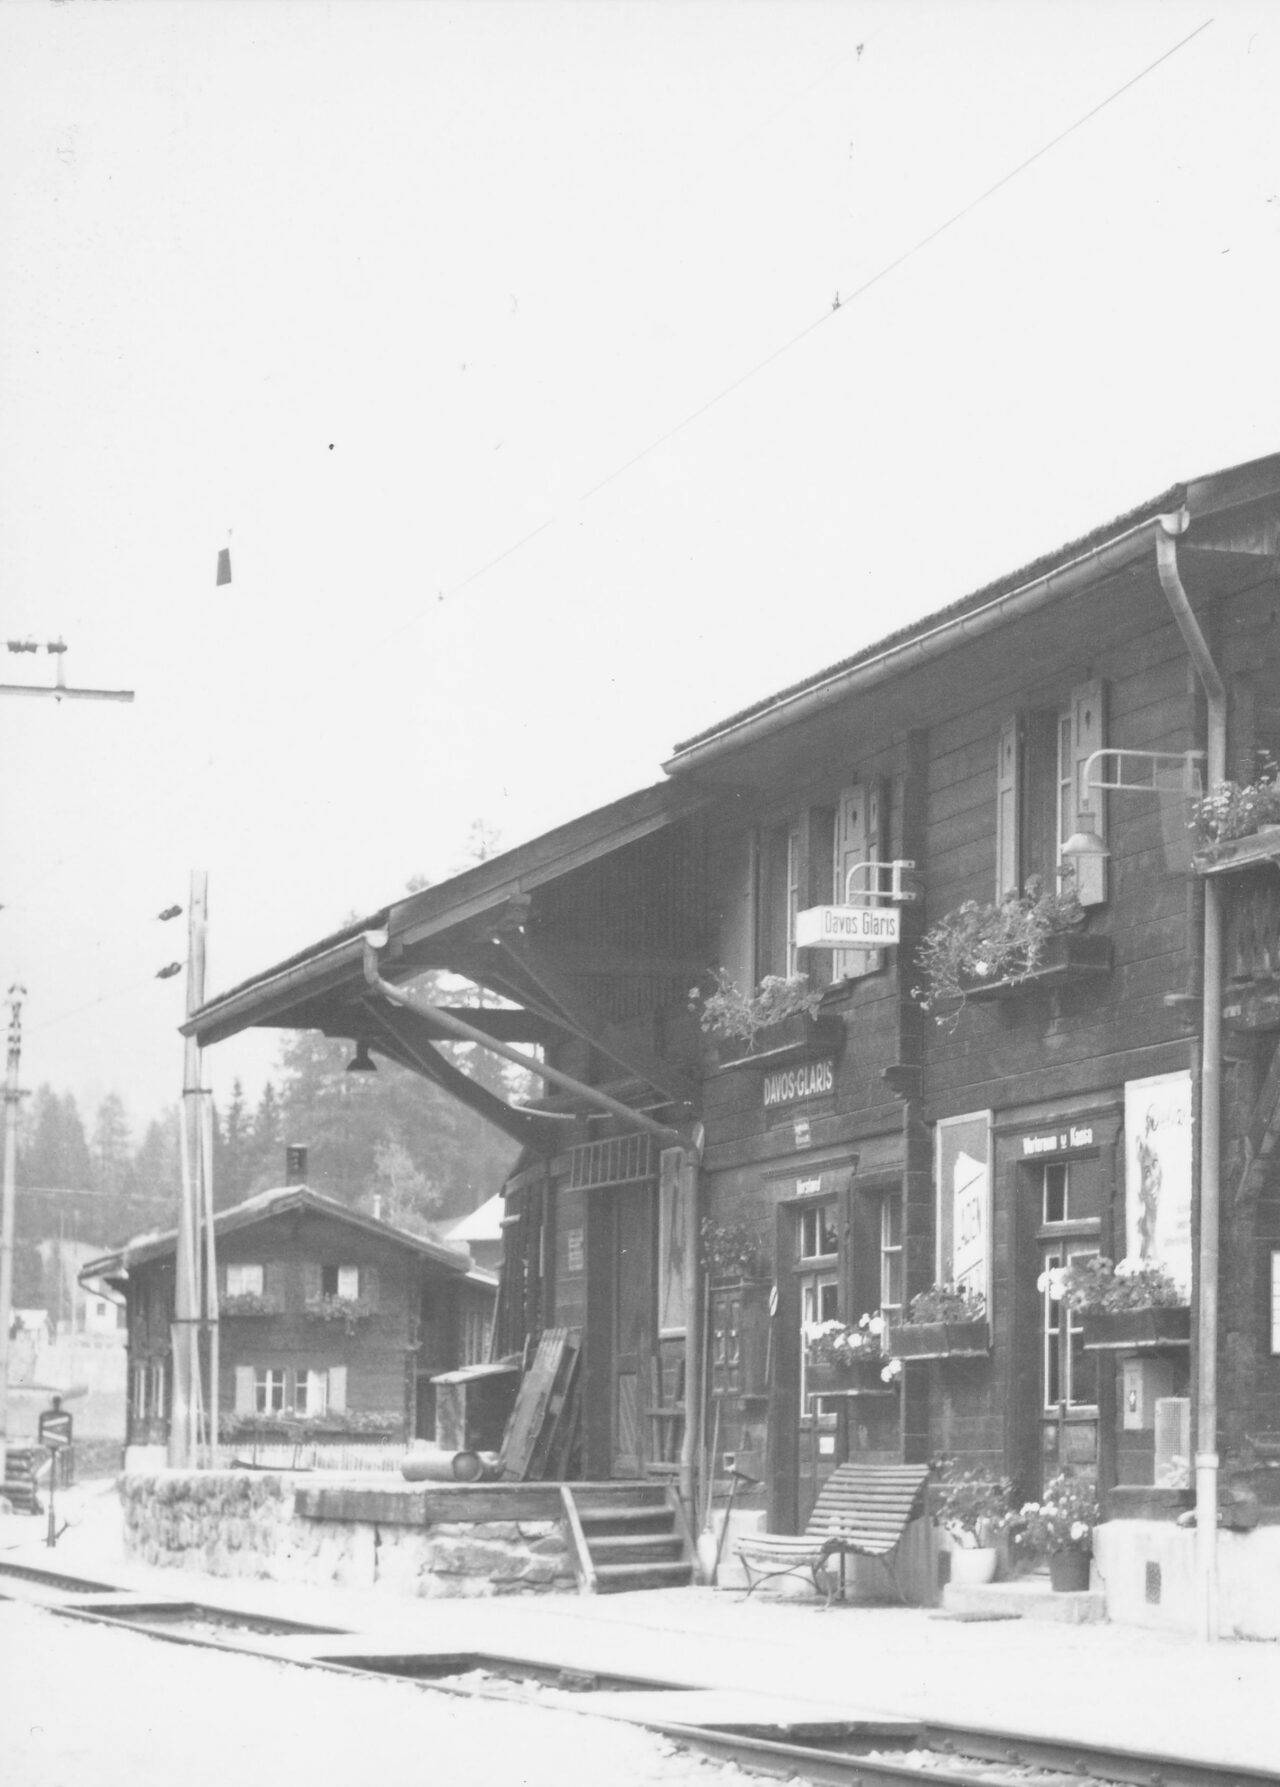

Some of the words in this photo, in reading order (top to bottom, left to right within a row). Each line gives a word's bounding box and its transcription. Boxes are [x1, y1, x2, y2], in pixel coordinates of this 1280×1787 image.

[824, 910, 858, 935] Davos
[862, 911, 896, 936] Glaris
[763, 1064, 833, 1106] DAVOS-GLARIS
